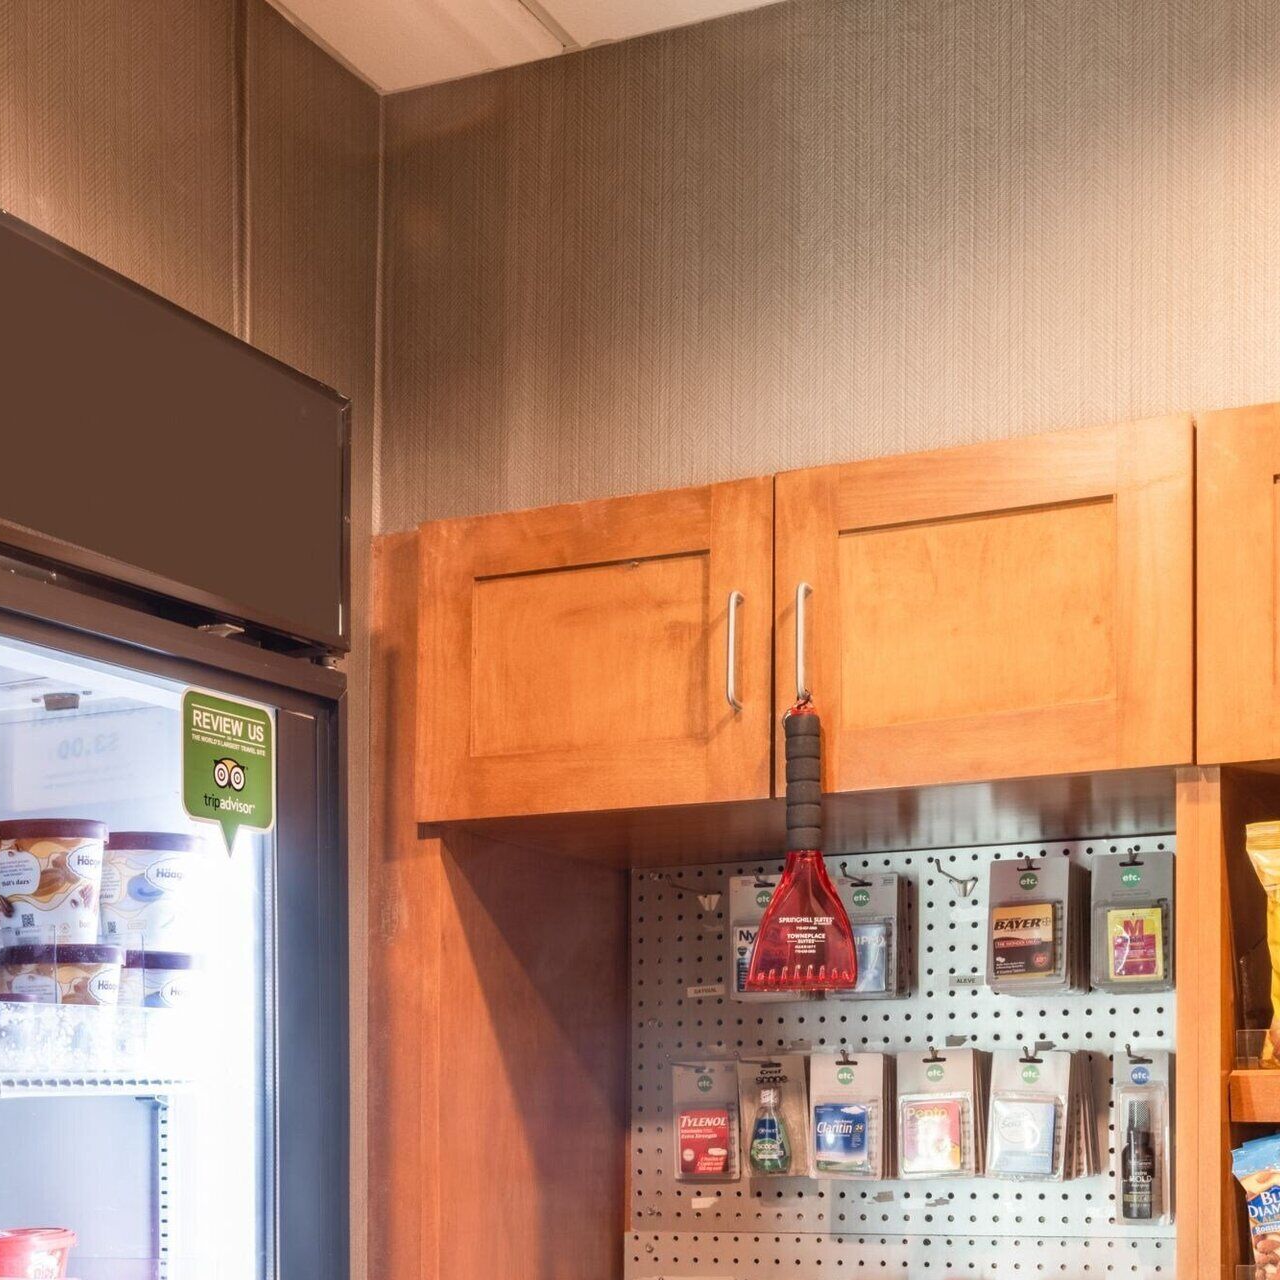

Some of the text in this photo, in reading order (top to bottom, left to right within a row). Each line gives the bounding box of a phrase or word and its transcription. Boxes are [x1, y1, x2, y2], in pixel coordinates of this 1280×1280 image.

[193, 709, 264, 742] REVIEW US
[204, 794, 253, 814] tripadvisor
[1020, 877, 1038, 886] etc.
[1122, 873, 1141, 882] etc.
[779, 916, 813, 925] SPRINGHILL
[994, 918, 1041, 931] BAYER
[1023, 1070, 1040, 1078] etc.
[1132, 1071, 1150, 1079] etc.
[756, 1074, 788, 1084] scope
[680, 1115, 727, 1127] TYLENOL
[817, 1121, 852, 1134] Claritin
[1129, 1174, 1152, 1183] HOLD
